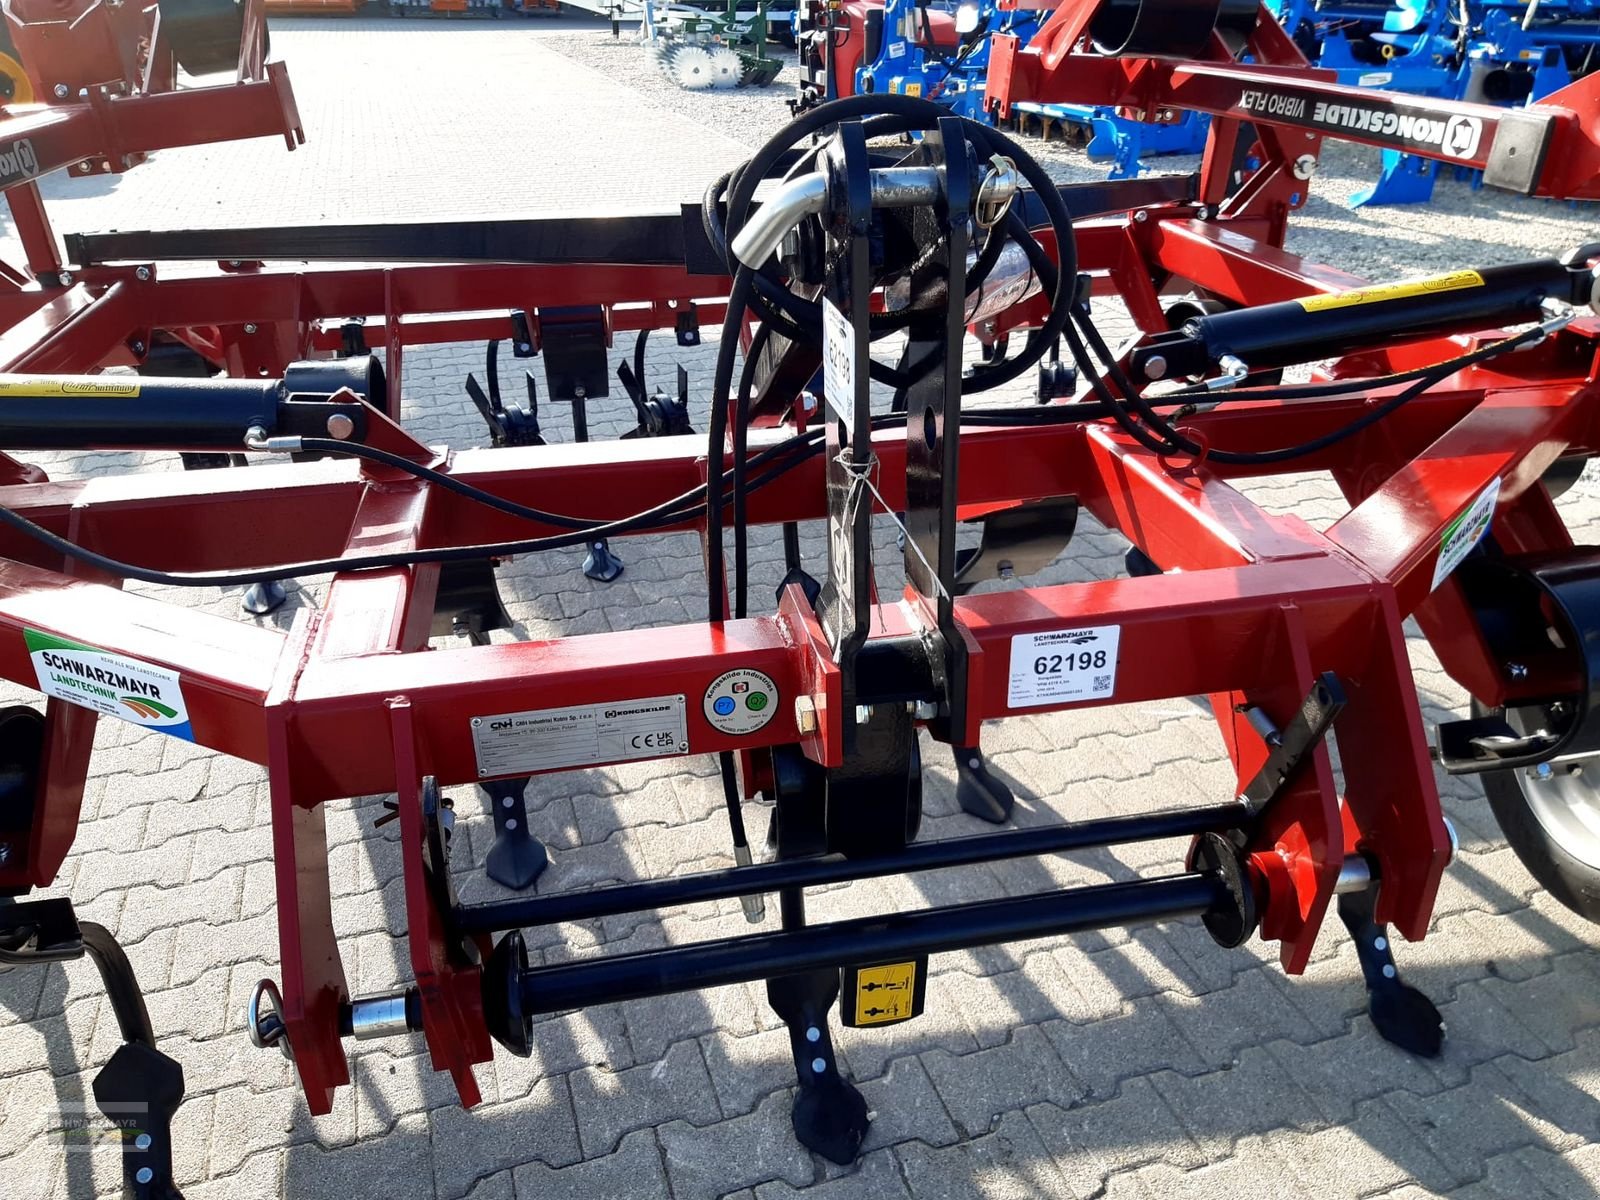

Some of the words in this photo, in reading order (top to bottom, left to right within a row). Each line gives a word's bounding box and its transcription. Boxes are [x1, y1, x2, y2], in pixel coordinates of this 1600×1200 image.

[732, 23, 752, 31] Fliegl
[1238, 90, 1268, 111] FLEX
[1268, 93, 1305, 118] VIBRO
[1313, 103, 1446, 145] KONGSKILDE
[1033, 630, 1093, 642] SCHWARZMAYR
[100, 656, 114, 665] MEHR
[115, 660, 125, 668] ALS
[125, 663, 136, 671] NUR
[1034, 650, 1106, 675] 62198
[42, 651, 161, 699] SCHWARZMAYR
[50, 672, 118, 700] LANDTECHNIK
[707, 672, 741, 699] Kongskilde
[743, 670, 774, 692] Industries
[718, 701, 731, 710] P7
[751, 697, 765, 705] Q7
[617, 706, 670, 716] KONGSKILDE
[528, 718, 552, 726] Industrial
[657, 732, 673, 740] UK
